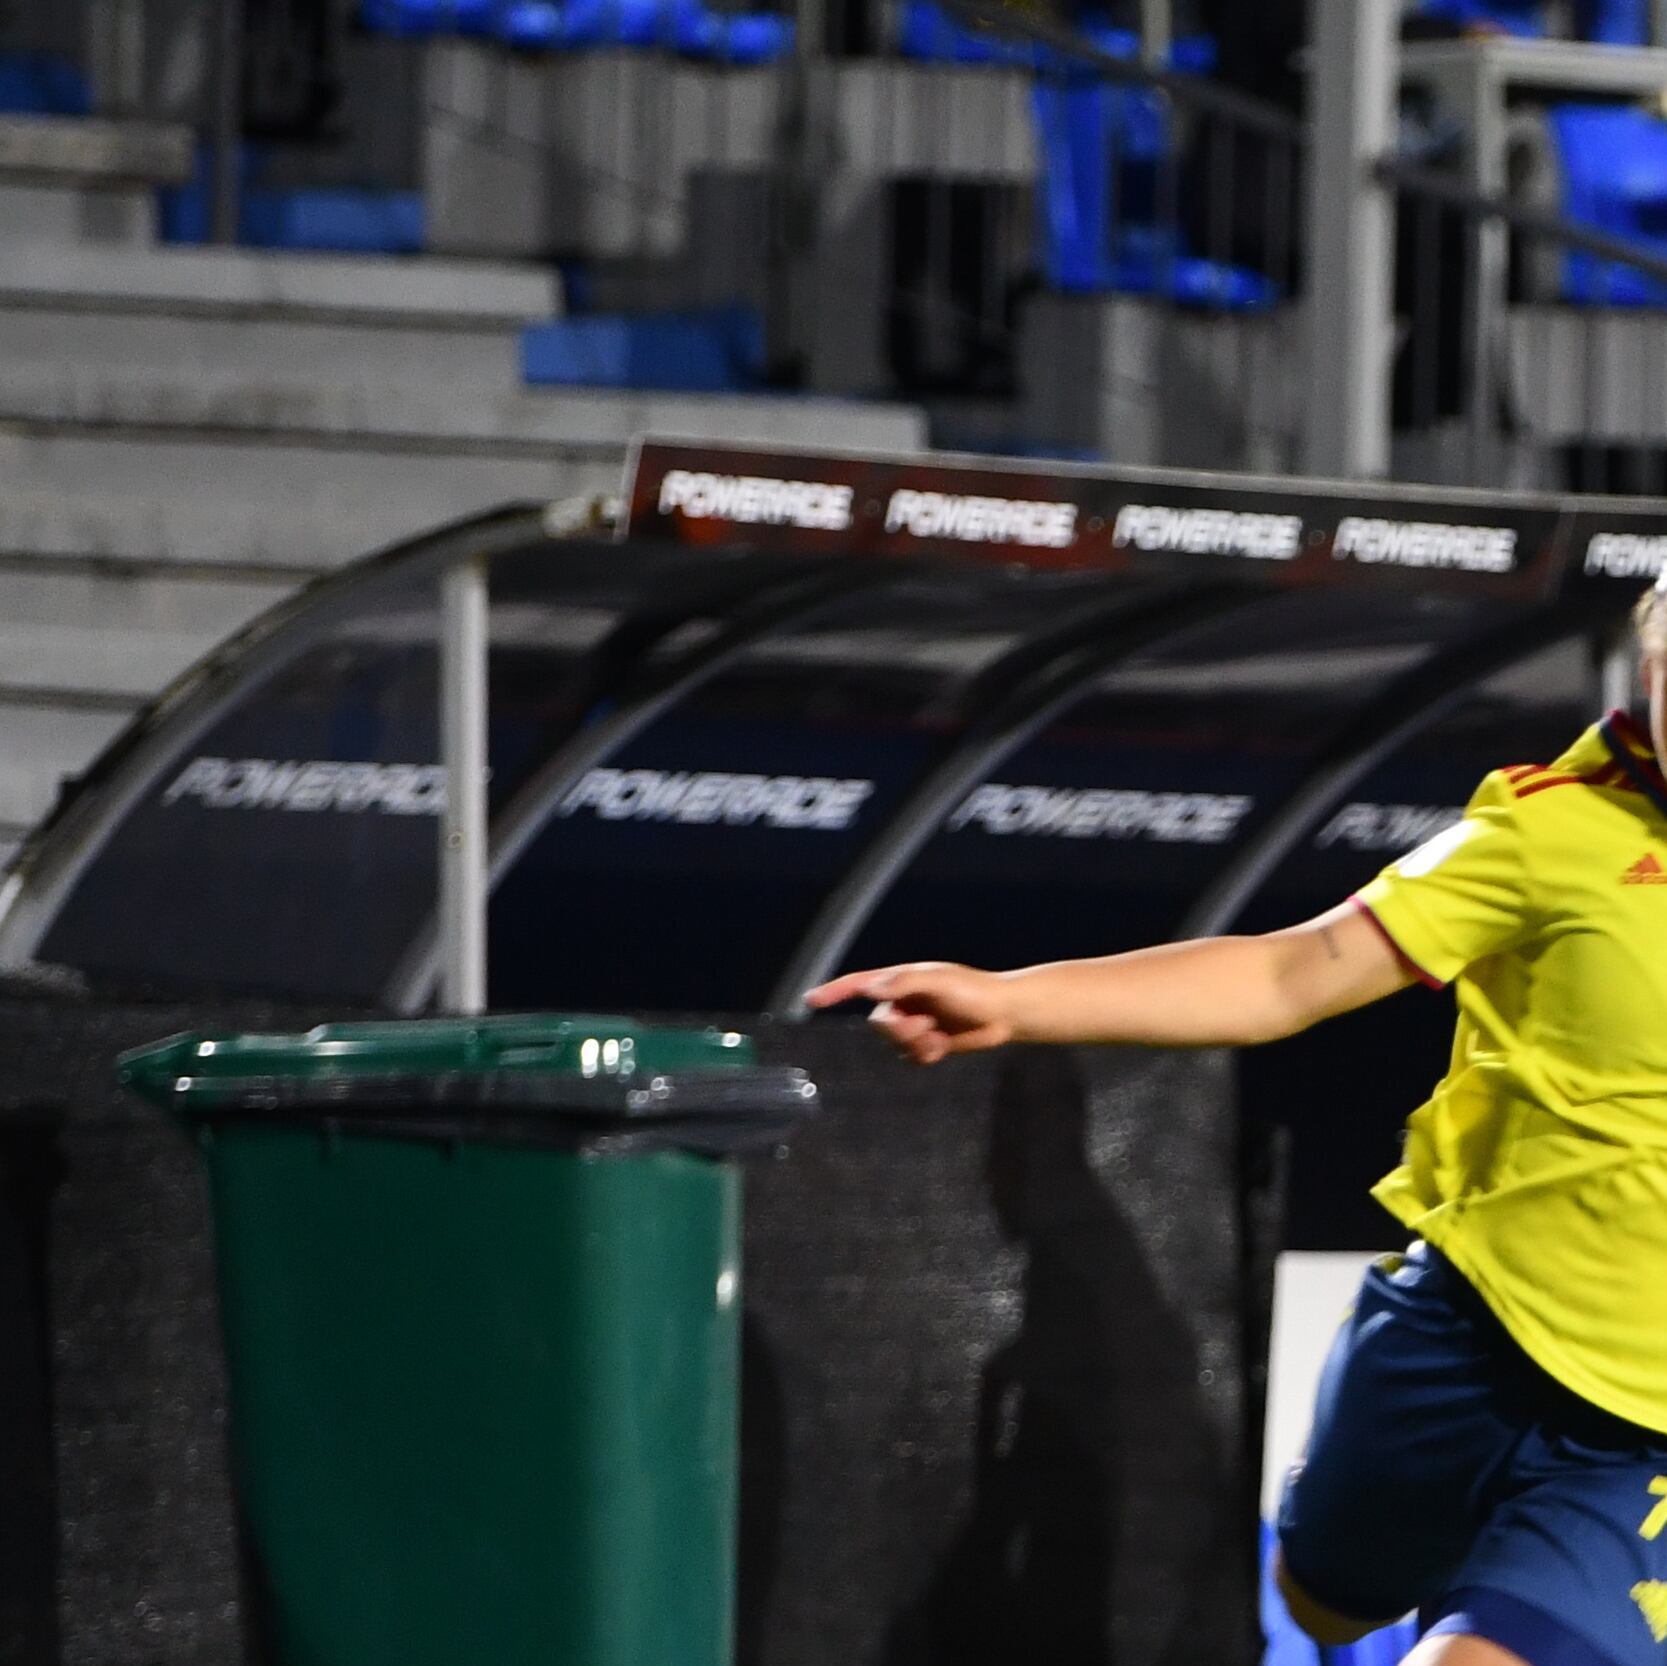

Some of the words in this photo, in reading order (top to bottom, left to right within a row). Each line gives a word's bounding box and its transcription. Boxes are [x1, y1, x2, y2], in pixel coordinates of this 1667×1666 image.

[659, 470, 853, 531] POWERADE
[885, 490, 1078, 548] POWERADE
[1112, 505, 1302, 560] POWERADE
[1332, 516, 1518, 574] POWERADE
[163, 757, 447, 817] POWERAD
[562, 767, 874, 830] POWERADE
[948, 782, 1252, 844] POWERADE
